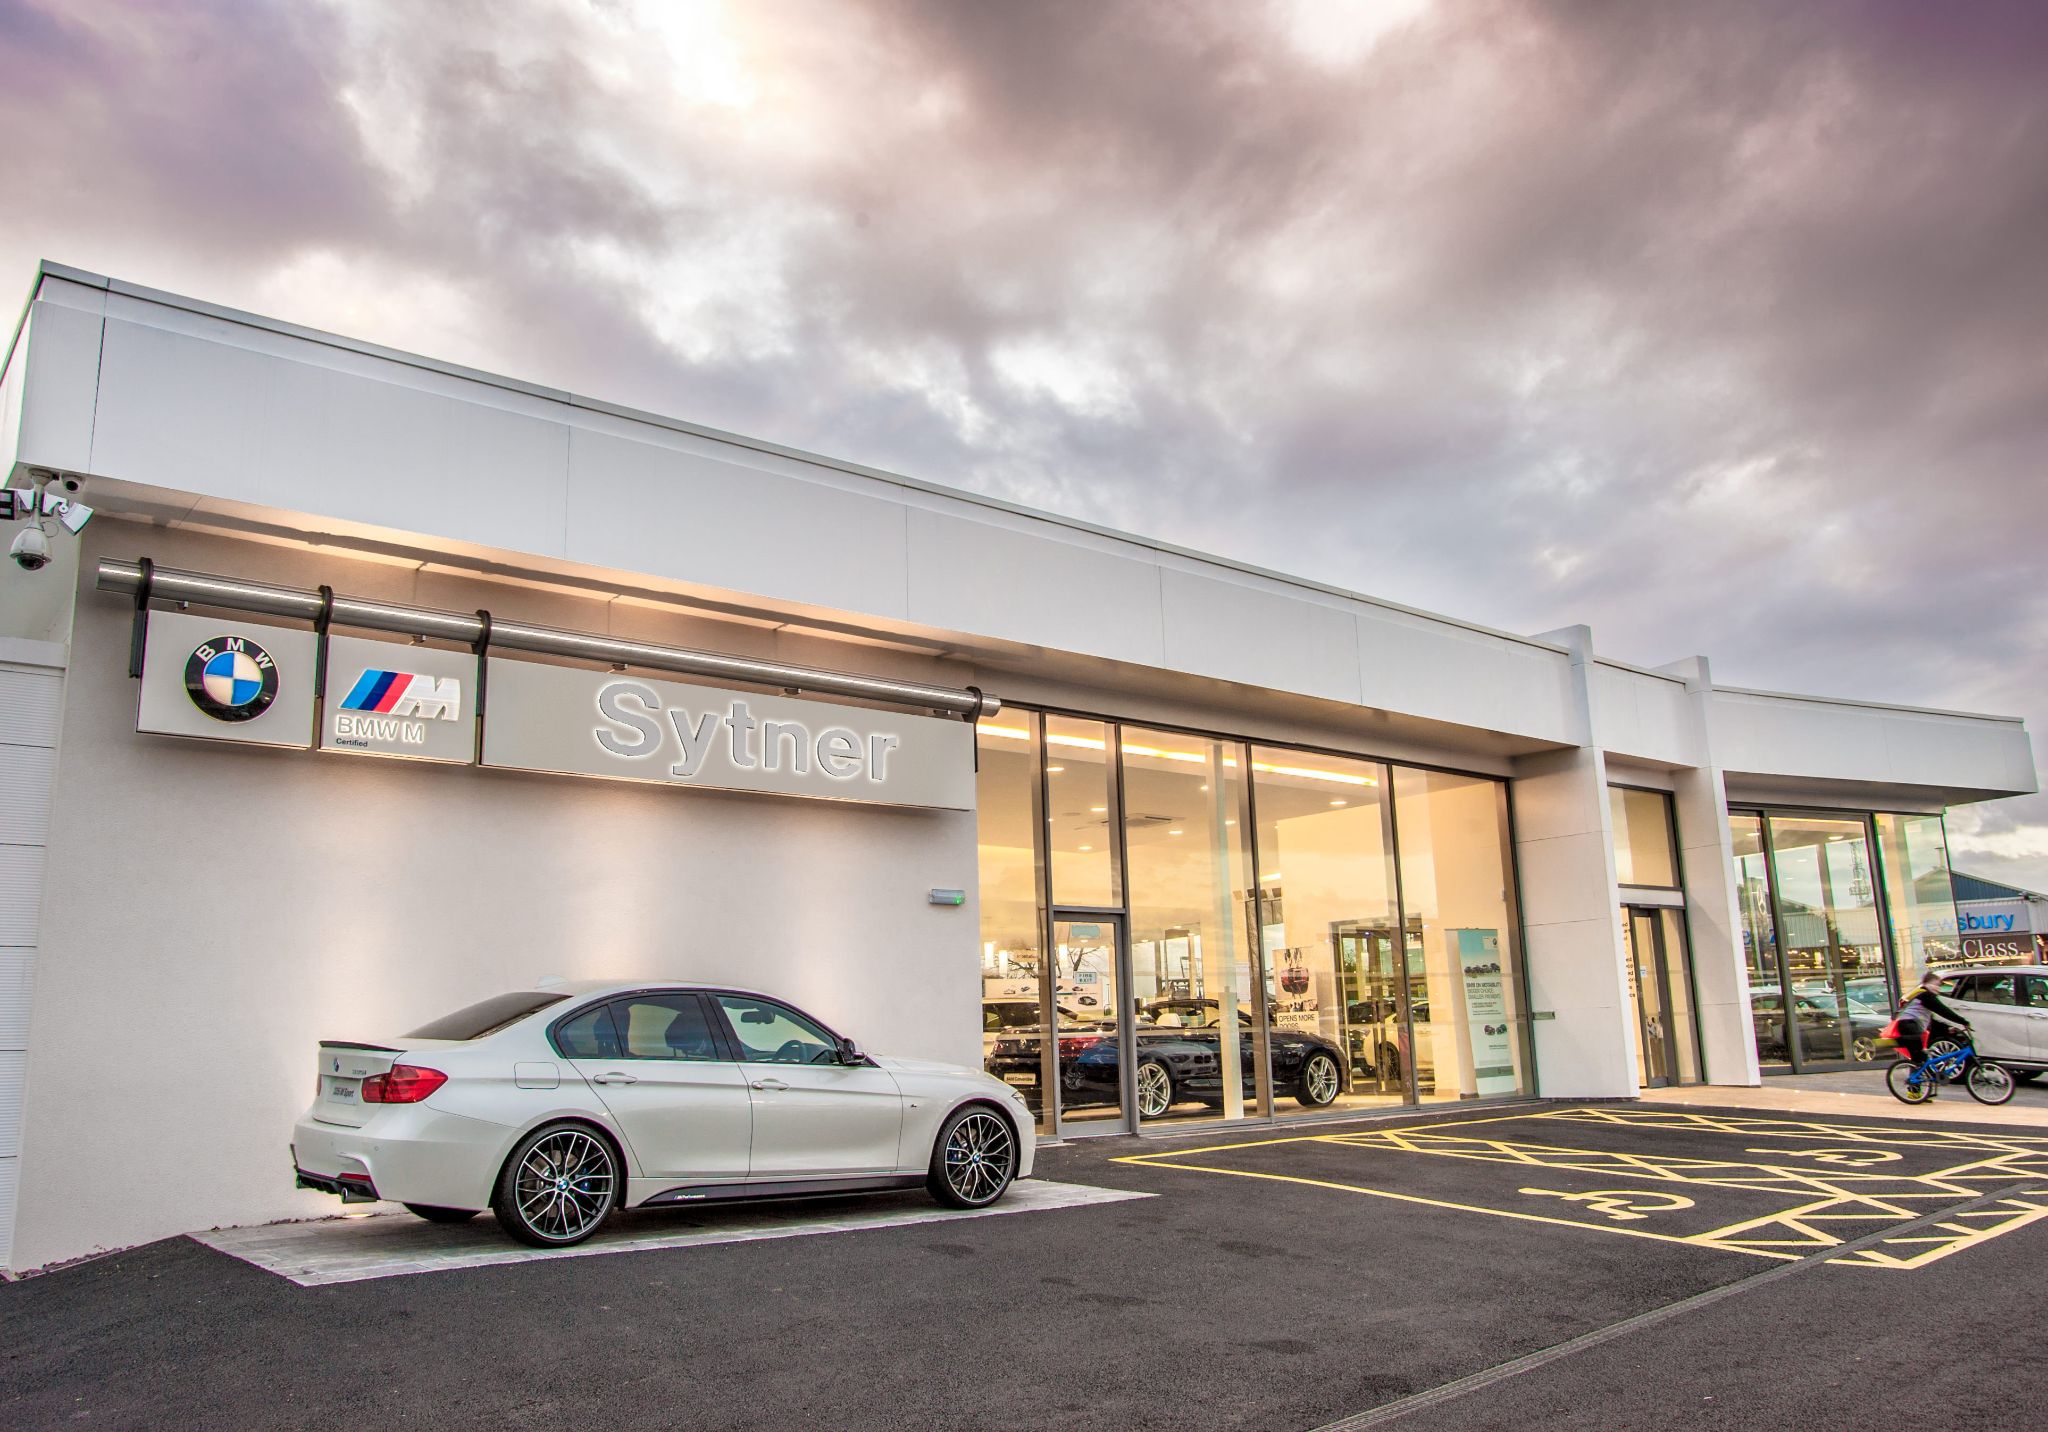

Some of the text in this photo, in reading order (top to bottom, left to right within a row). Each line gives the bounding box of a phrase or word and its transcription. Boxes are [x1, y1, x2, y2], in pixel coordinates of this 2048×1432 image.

[195, 638, 273, 669] BMW
[337, 716, 424, 743] BMW M
[595, 681, 898, 780] Sytner
[336, 738, 368, 747] Certified
[1963, 939, 2018, 959] Class
[1278, 1013, 1315, 1022] OPENS MORE
